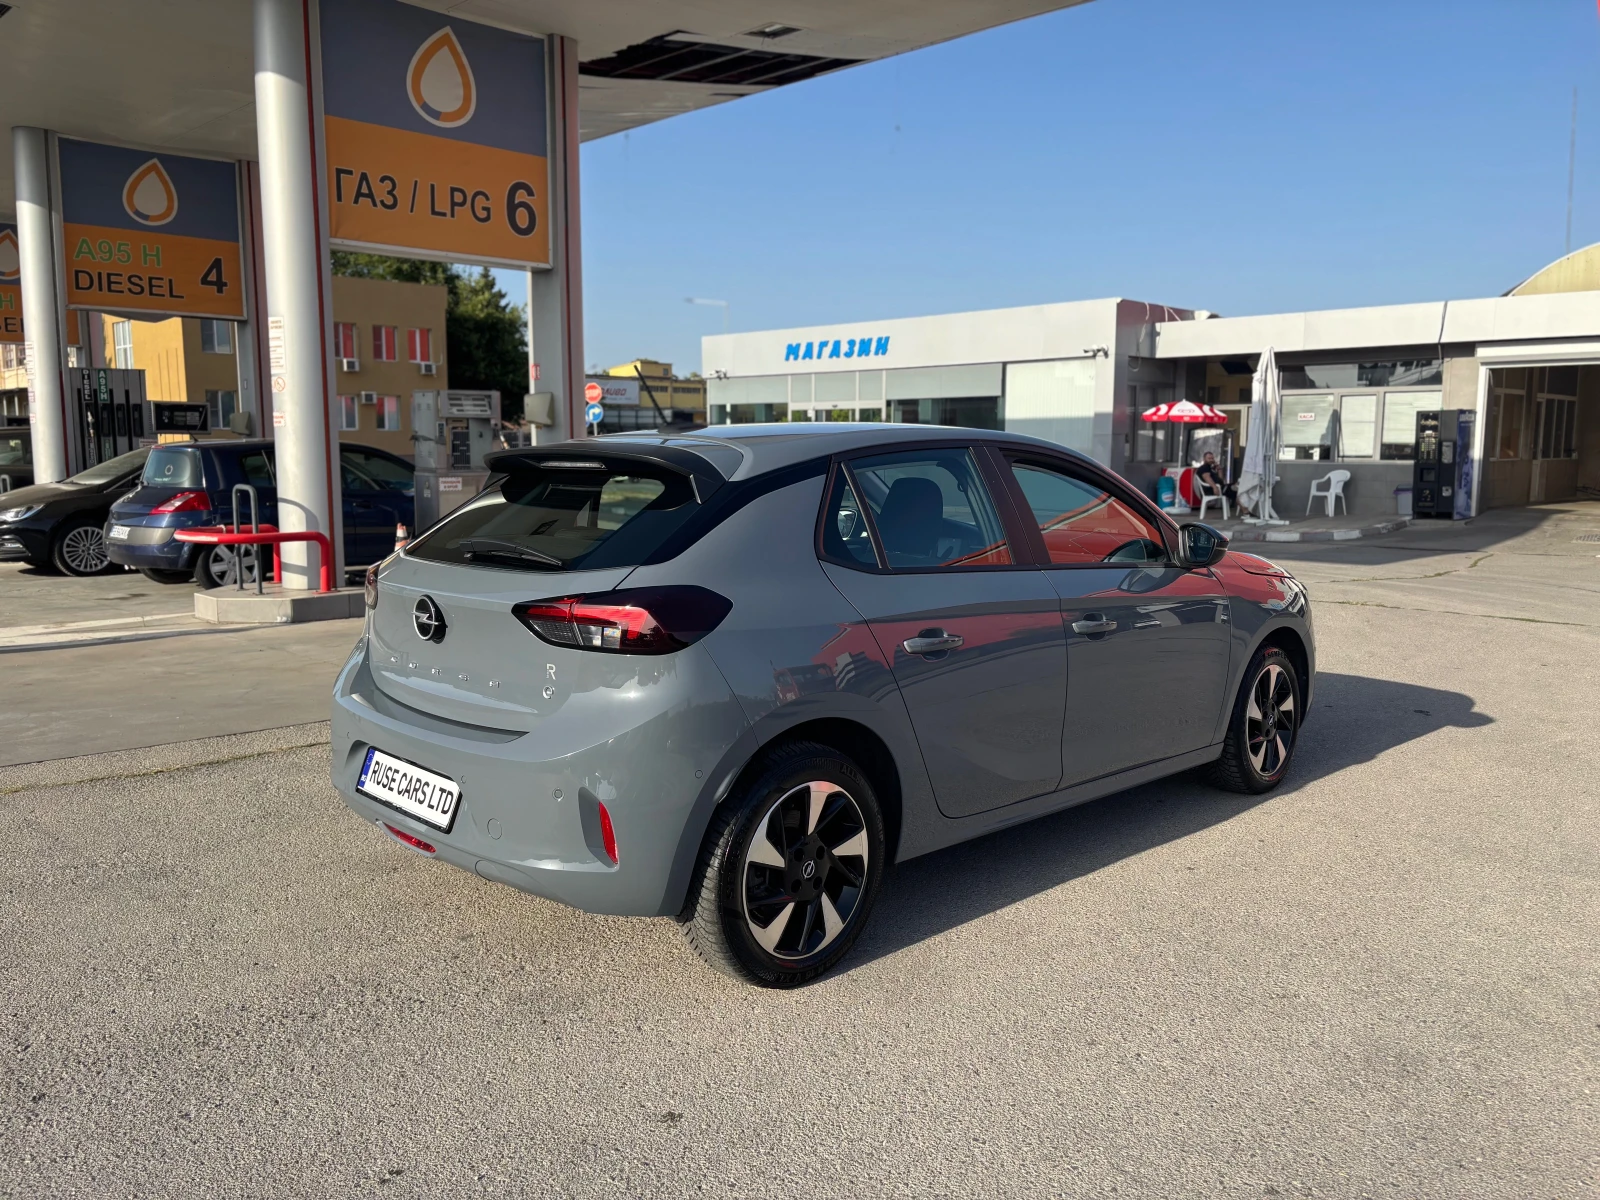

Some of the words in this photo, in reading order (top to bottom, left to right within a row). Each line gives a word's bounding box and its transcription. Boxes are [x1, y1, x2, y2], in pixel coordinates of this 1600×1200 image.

[335, 167, 399, 211] ГАЗ
[429, 183, 492, 224] LPG
[505, 180, 538, 237] 6
[73, 237, 133, 265] A95
[141, 244, 162, 267] H
[73, 268, 185, 300] DIESEL
[200, 257, 229, 295] 4
[784, 335, 891, 362] МАГАЗИН
[82, 369, 91, 400] DIESEL
[369, 760, 400, 792] RUSE
[397, 772, 430, 805] CARS
[427, 784, 454, 815] LTD
